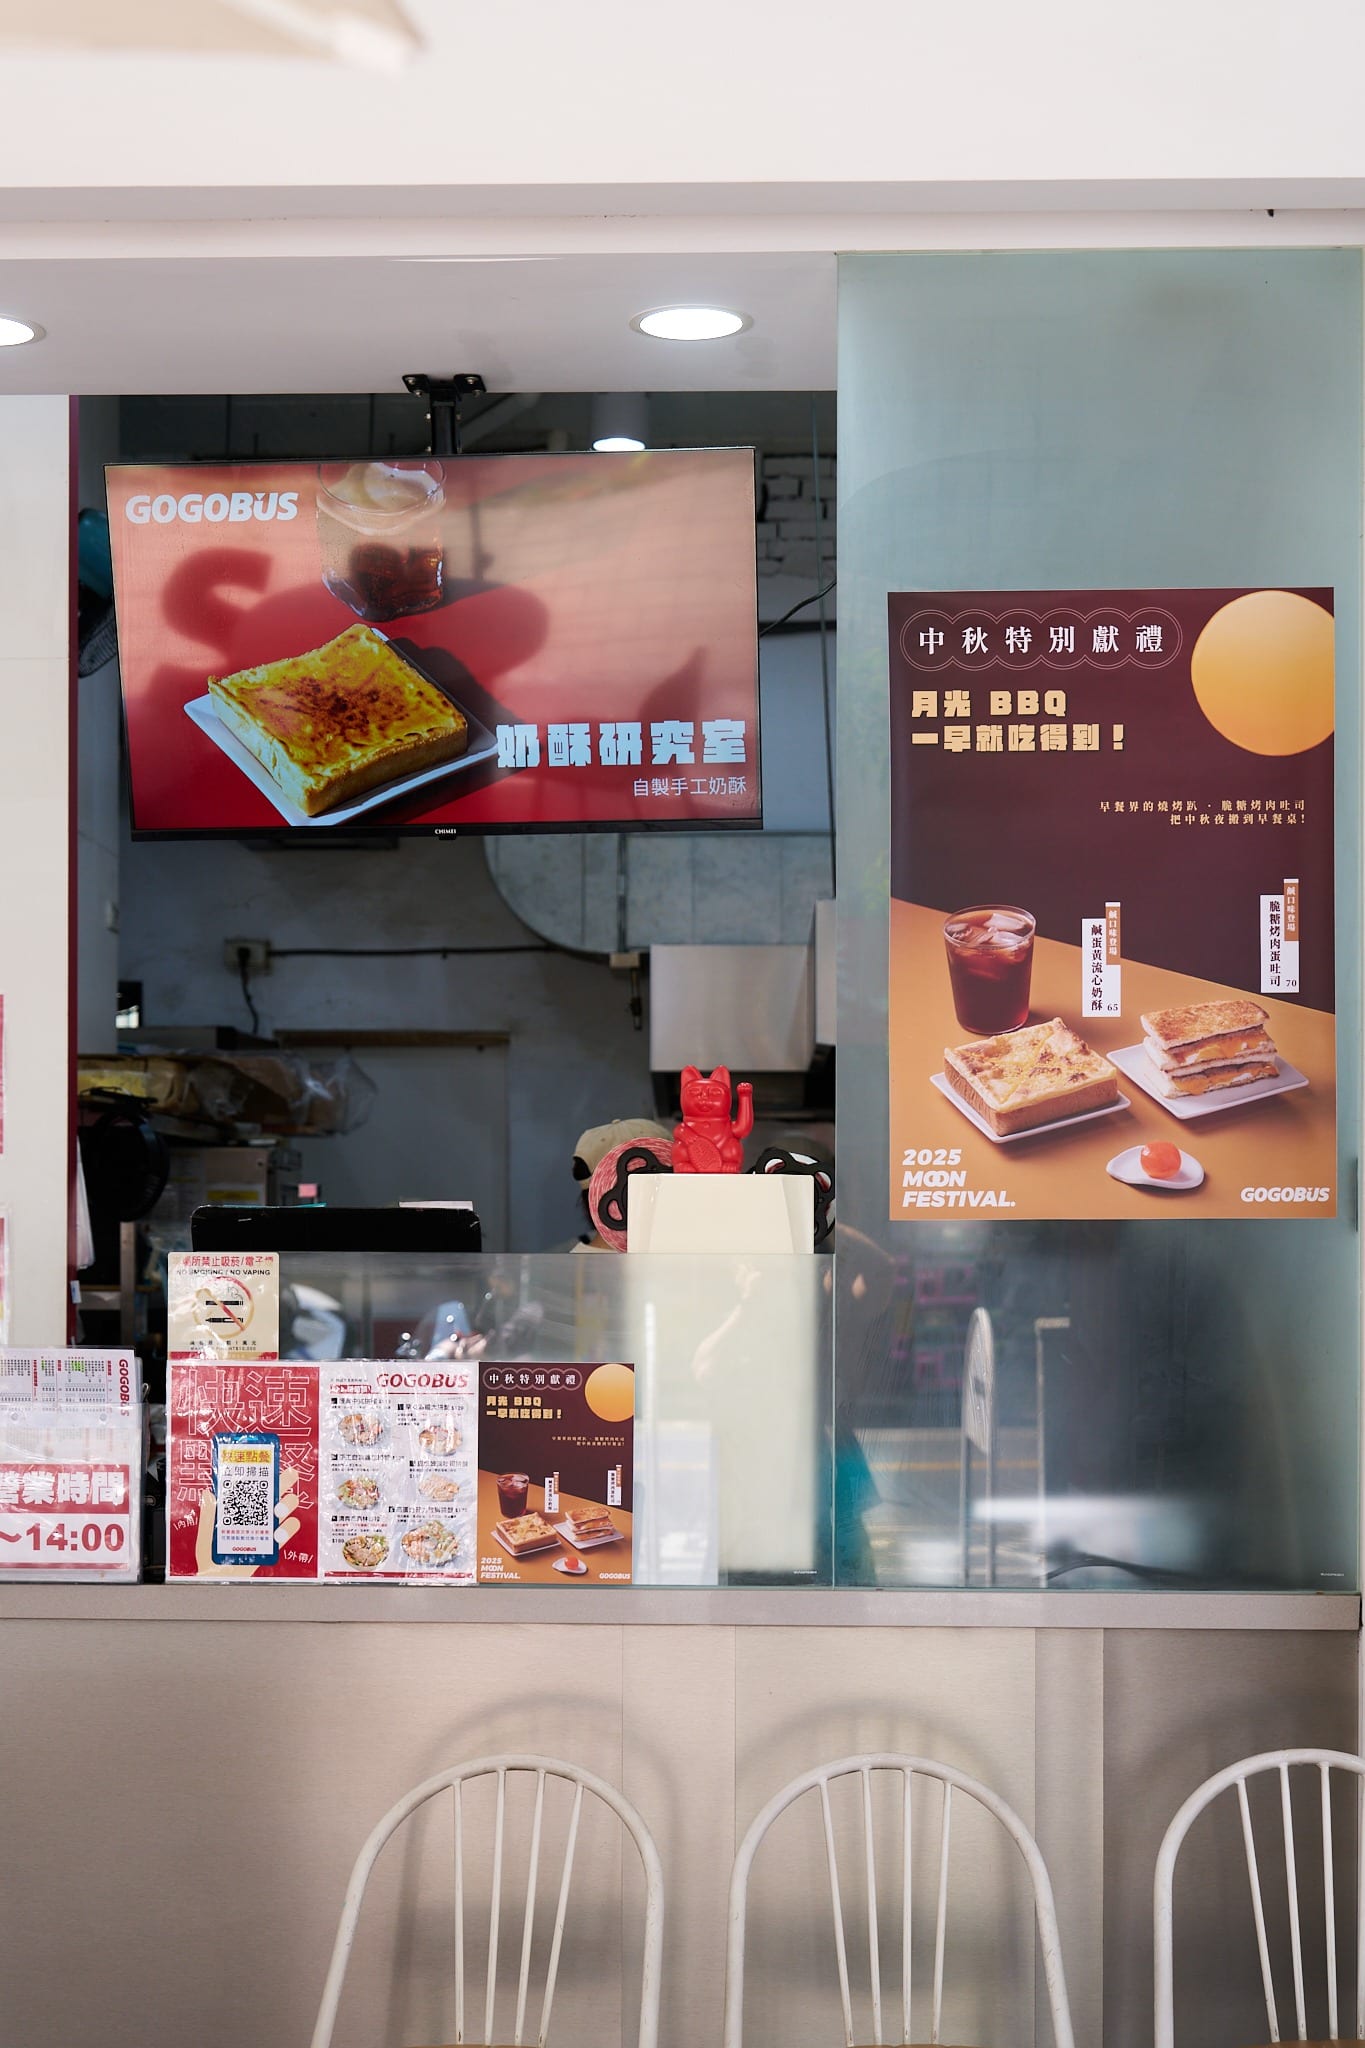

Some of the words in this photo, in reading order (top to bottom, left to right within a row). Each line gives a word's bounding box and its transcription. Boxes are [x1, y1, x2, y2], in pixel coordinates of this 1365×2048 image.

[125, 492, 299, 524] GOGOBUS
[919, 625, 1163, 654] 中秋特別獻禮
[912, 690, 971, 717] 月光
[990, 690, 1066, 716] BBQ
[496, 719, 746, 768] 奶酥研究室
[633, 776, 747, 797] 自製手工奶酥
[1269, 900, 1281, 987] 脆糖烤肉蛋吐司
[1285, 979, 1297, 987] 70
[1107, 1003, 1119, 1012] 65
[902, 1149, 961, 1165] 2025
[902, 1170, 967, 1187] MOON
[902, 1190, 1016, 1207] FESTIVAL.
[1240, 1187, 1330, 1203] GOGOBUS
[376, 1373, 469, 1388] GOGOBUS
